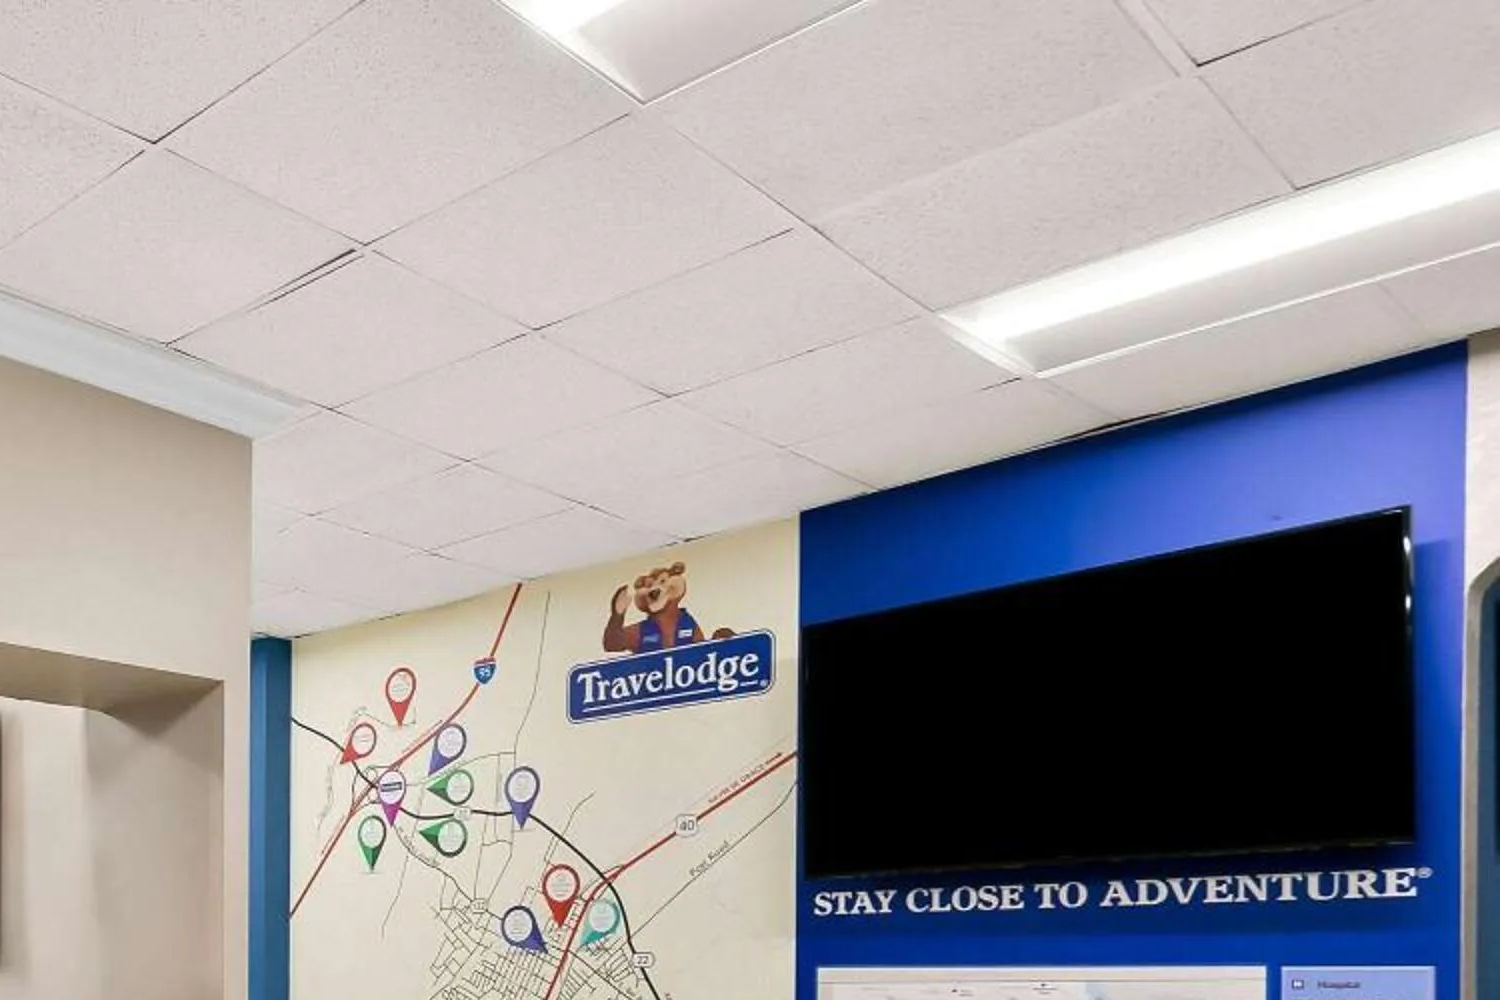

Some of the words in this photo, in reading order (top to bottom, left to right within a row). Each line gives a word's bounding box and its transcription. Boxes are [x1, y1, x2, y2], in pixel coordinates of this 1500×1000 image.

[576, 651, 760, 706] Travelodge
[678, 817, 696, 832] 40
[813, 889, 897, 917] STAY
[905, 884, 1026, 914] CLOSE
[1033, 881, 1089, 909] TO
[636, 955, 650, 965] 22
